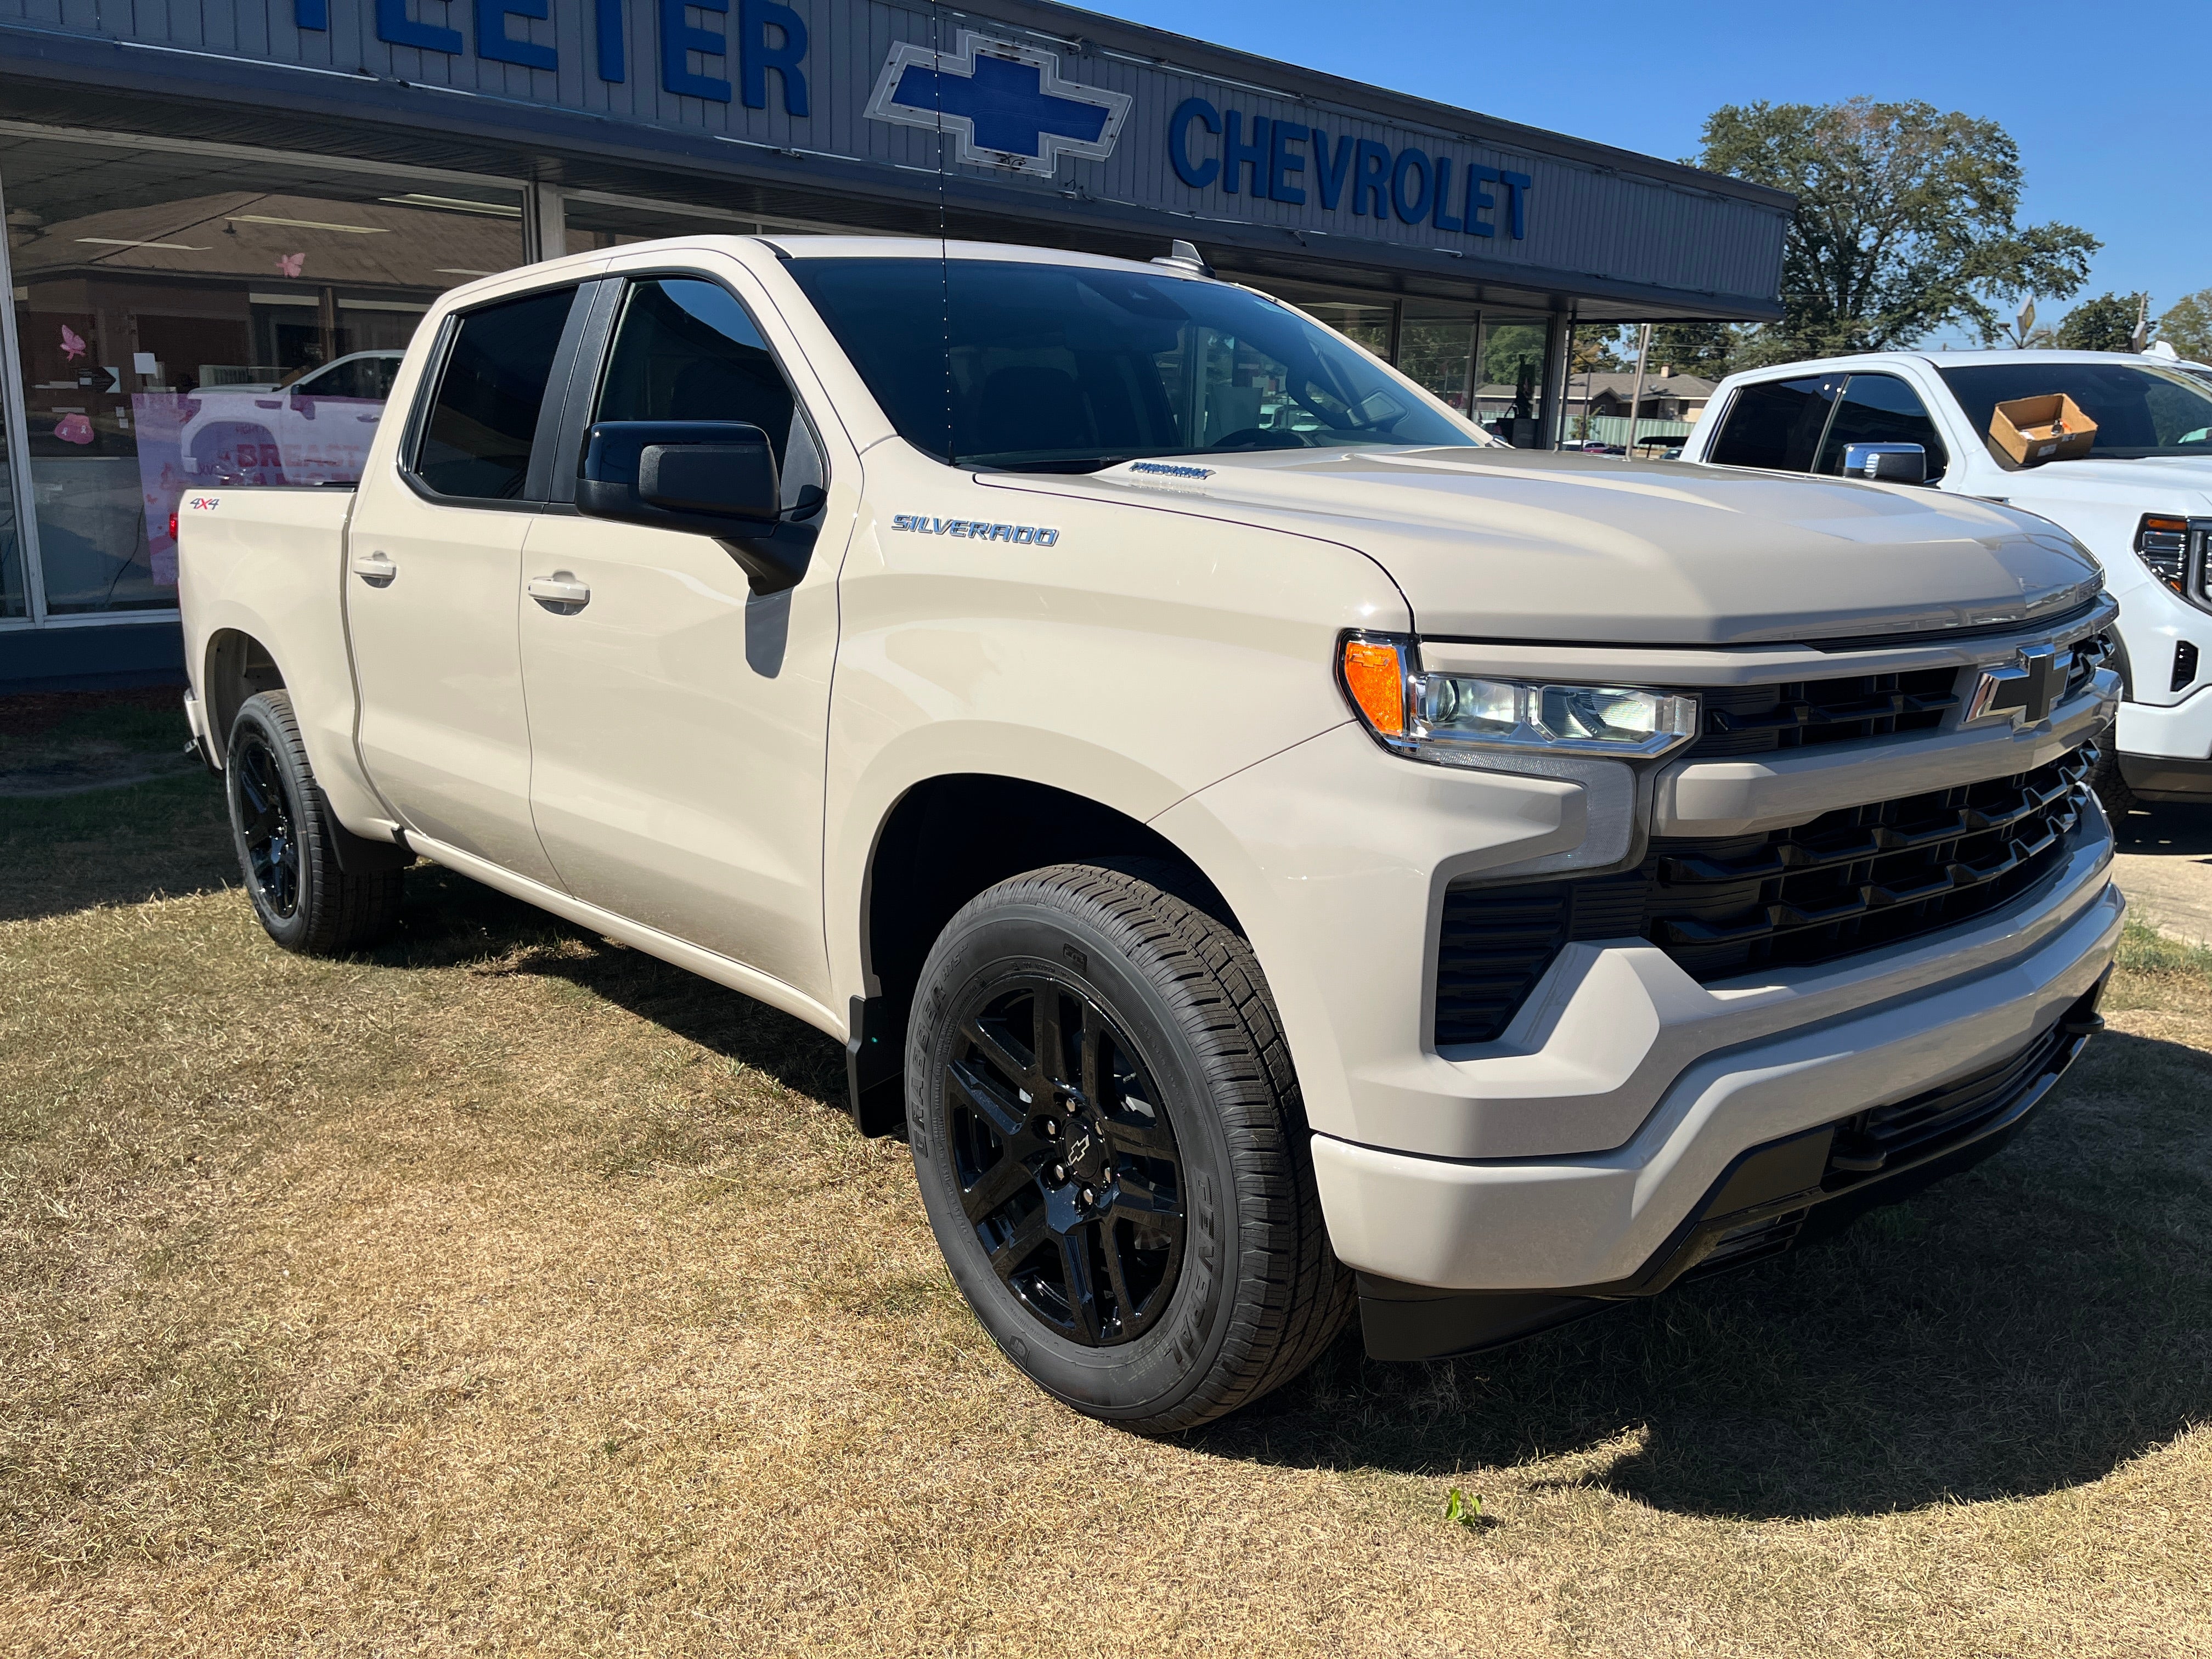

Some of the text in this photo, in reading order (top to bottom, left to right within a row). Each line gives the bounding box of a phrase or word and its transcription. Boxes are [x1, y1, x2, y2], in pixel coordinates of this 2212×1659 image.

[295, 0, 810, 117] EER
[1169, 97, 1532, 240] CHEVROLET
[190, 498, 219, 510] 4X4
[236, 443, 361, 467] BREAST
[891, 514, 1059, 547] SILVERADO
[911, 979, 946, 1158] GRABBER
[1164, 1170, 1215, 1364] GENERAL
